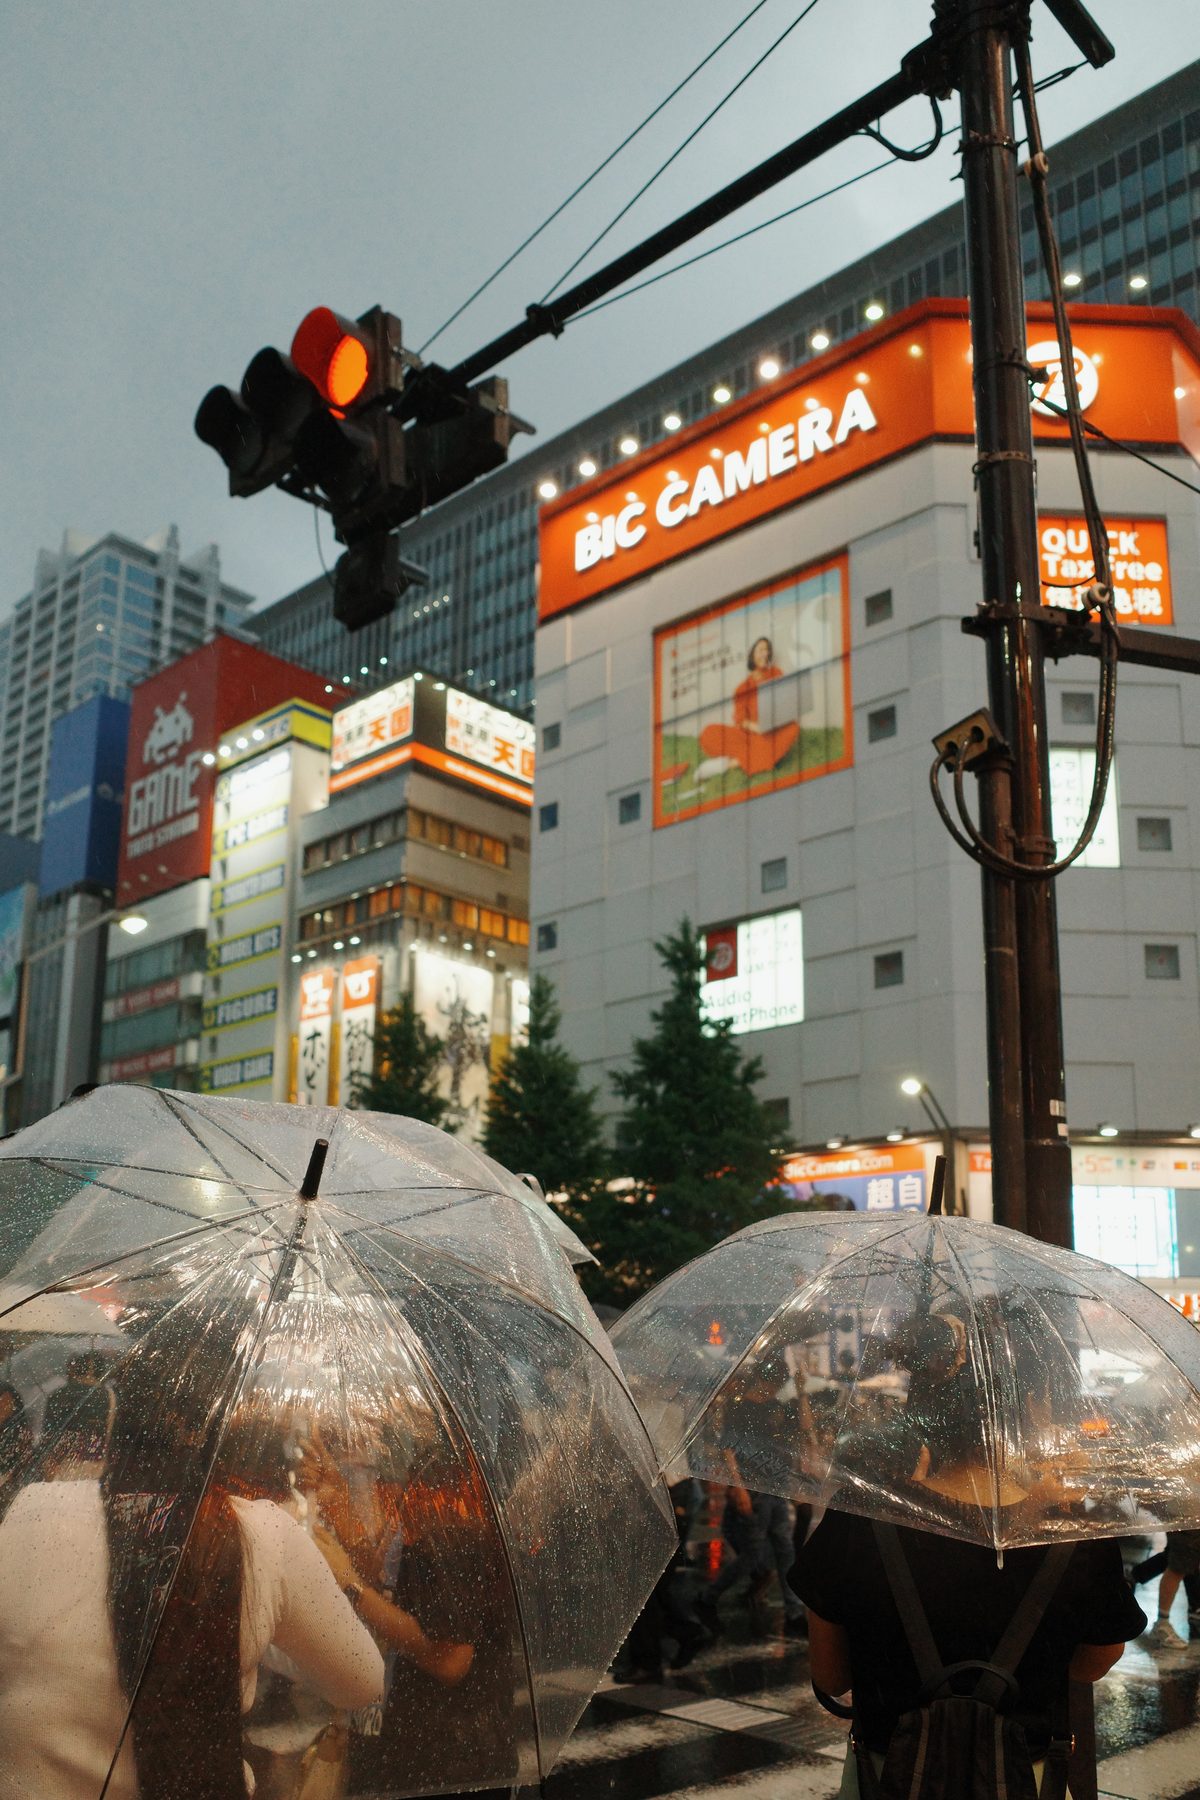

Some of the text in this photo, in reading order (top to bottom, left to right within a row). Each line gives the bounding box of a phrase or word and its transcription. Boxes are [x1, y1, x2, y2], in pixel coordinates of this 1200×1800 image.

[574, 387, 877, 572] BIC CAMERA
[1042, 527, 1140, 556] QUCK
[1042, 552, 1095, 579] Tax
[127, 750, 202, 837] GAME
